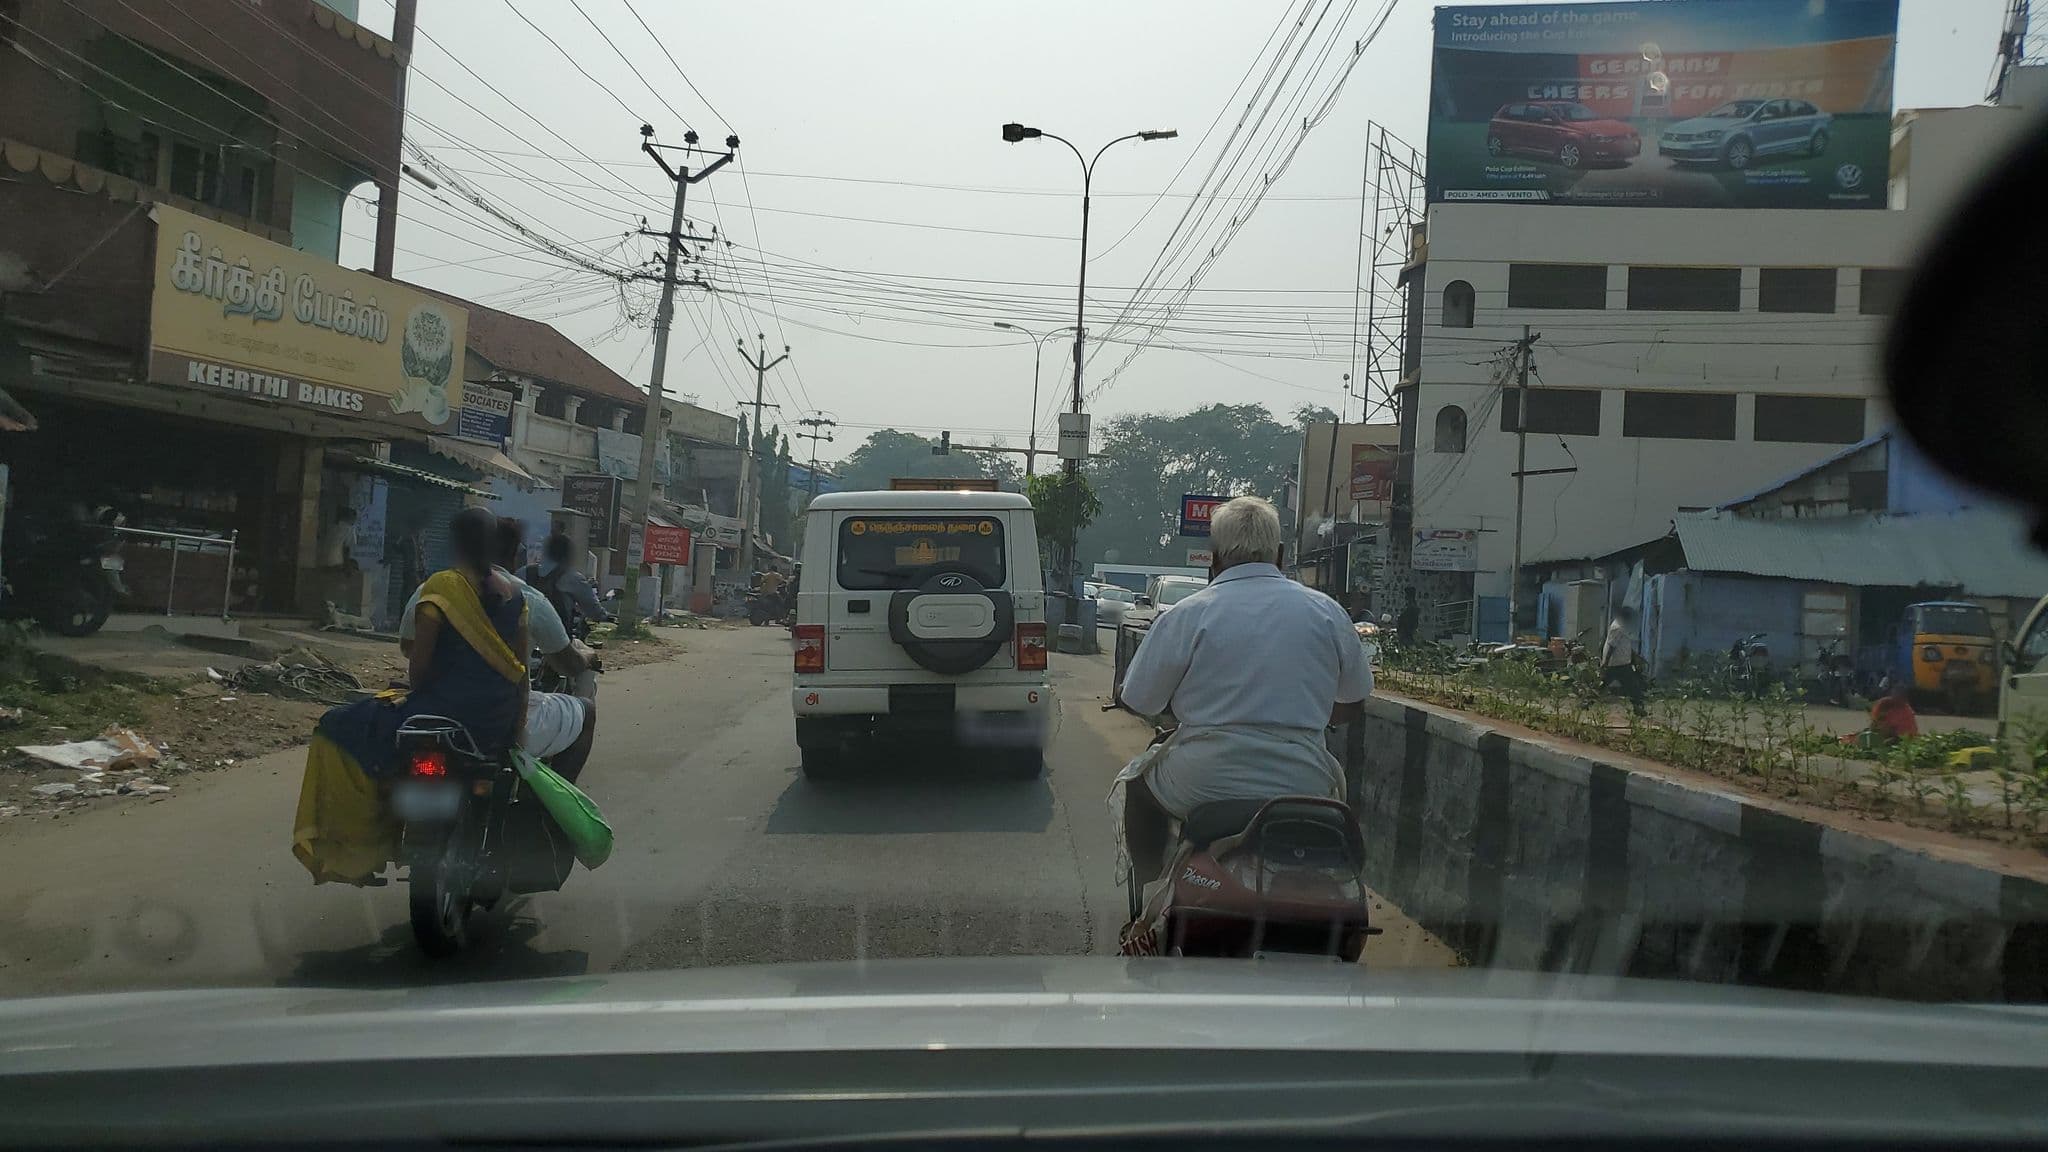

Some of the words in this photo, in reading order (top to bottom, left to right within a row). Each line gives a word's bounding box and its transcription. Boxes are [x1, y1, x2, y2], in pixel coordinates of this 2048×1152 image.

[1452, 14, 1487, 29] Stay
[1490, 13, 1538, 26] ahead
[1542, 12, 1559, 25] of
[1562, 11, 1588, 25] the
[1451, 31, 1519, 43] Introducing
[1527, 85, 1629, 100] CHEERS
[1675, 84, 1724, 99] FOR
[170, 230, 287, 326] கீர்த்தி
[292, 272, 389, 344] பேக்ஸ்
[188, 361, 289, 399] KEERTHI
[300, 383, 363, 412] BAKES
[805, 692, 819, 706] அ
[1028, 691, 1039, 704] G
[1182, 867, 1221, 889] Pleasure
